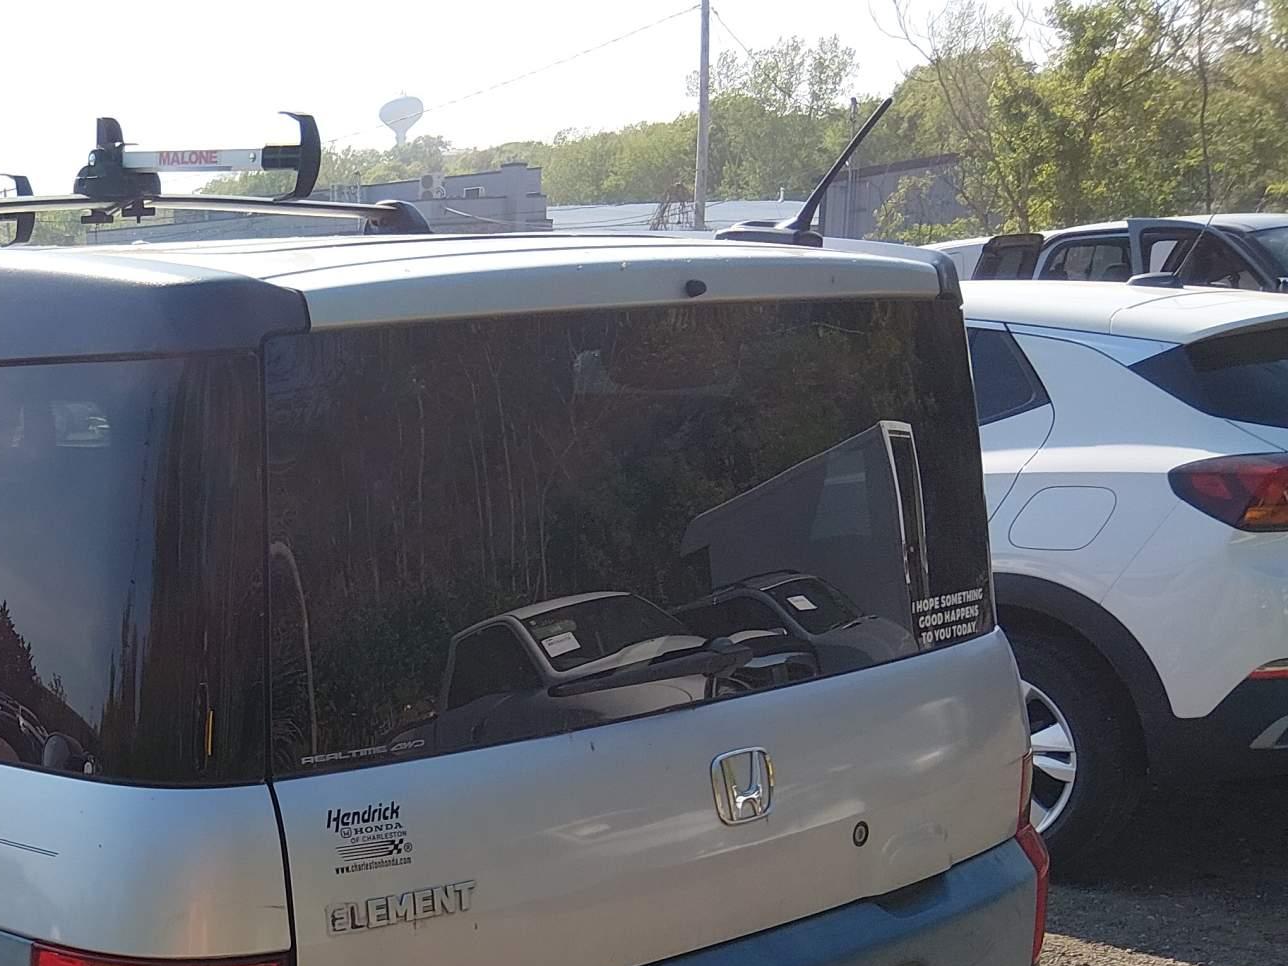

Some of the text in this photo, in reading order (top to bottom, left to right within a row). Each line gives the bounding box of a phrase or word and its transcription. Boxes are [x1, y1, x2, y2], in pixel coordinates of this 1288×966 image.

[158, 150, 218, 166] MALONE
[916, 597, 940, 613] HOPE
[940, 587, 984, 608] SOMETHING
[918, 605, 979, 628] GOOD HAPPENS
[921, 631, 934, 644] TO
[934, 625, 952, 642] YOU
[300, 745, 388, 765] REALTIME
[326, 800, 401, 833] Hendrick
[350, 830, 408, 844] OF CHARLESTON
[354, 822, 404, 836] HONDA
[335, 857, 412, 875] www.charlestonhonda.com
[325, 879, 477, 937] ELEMENT
